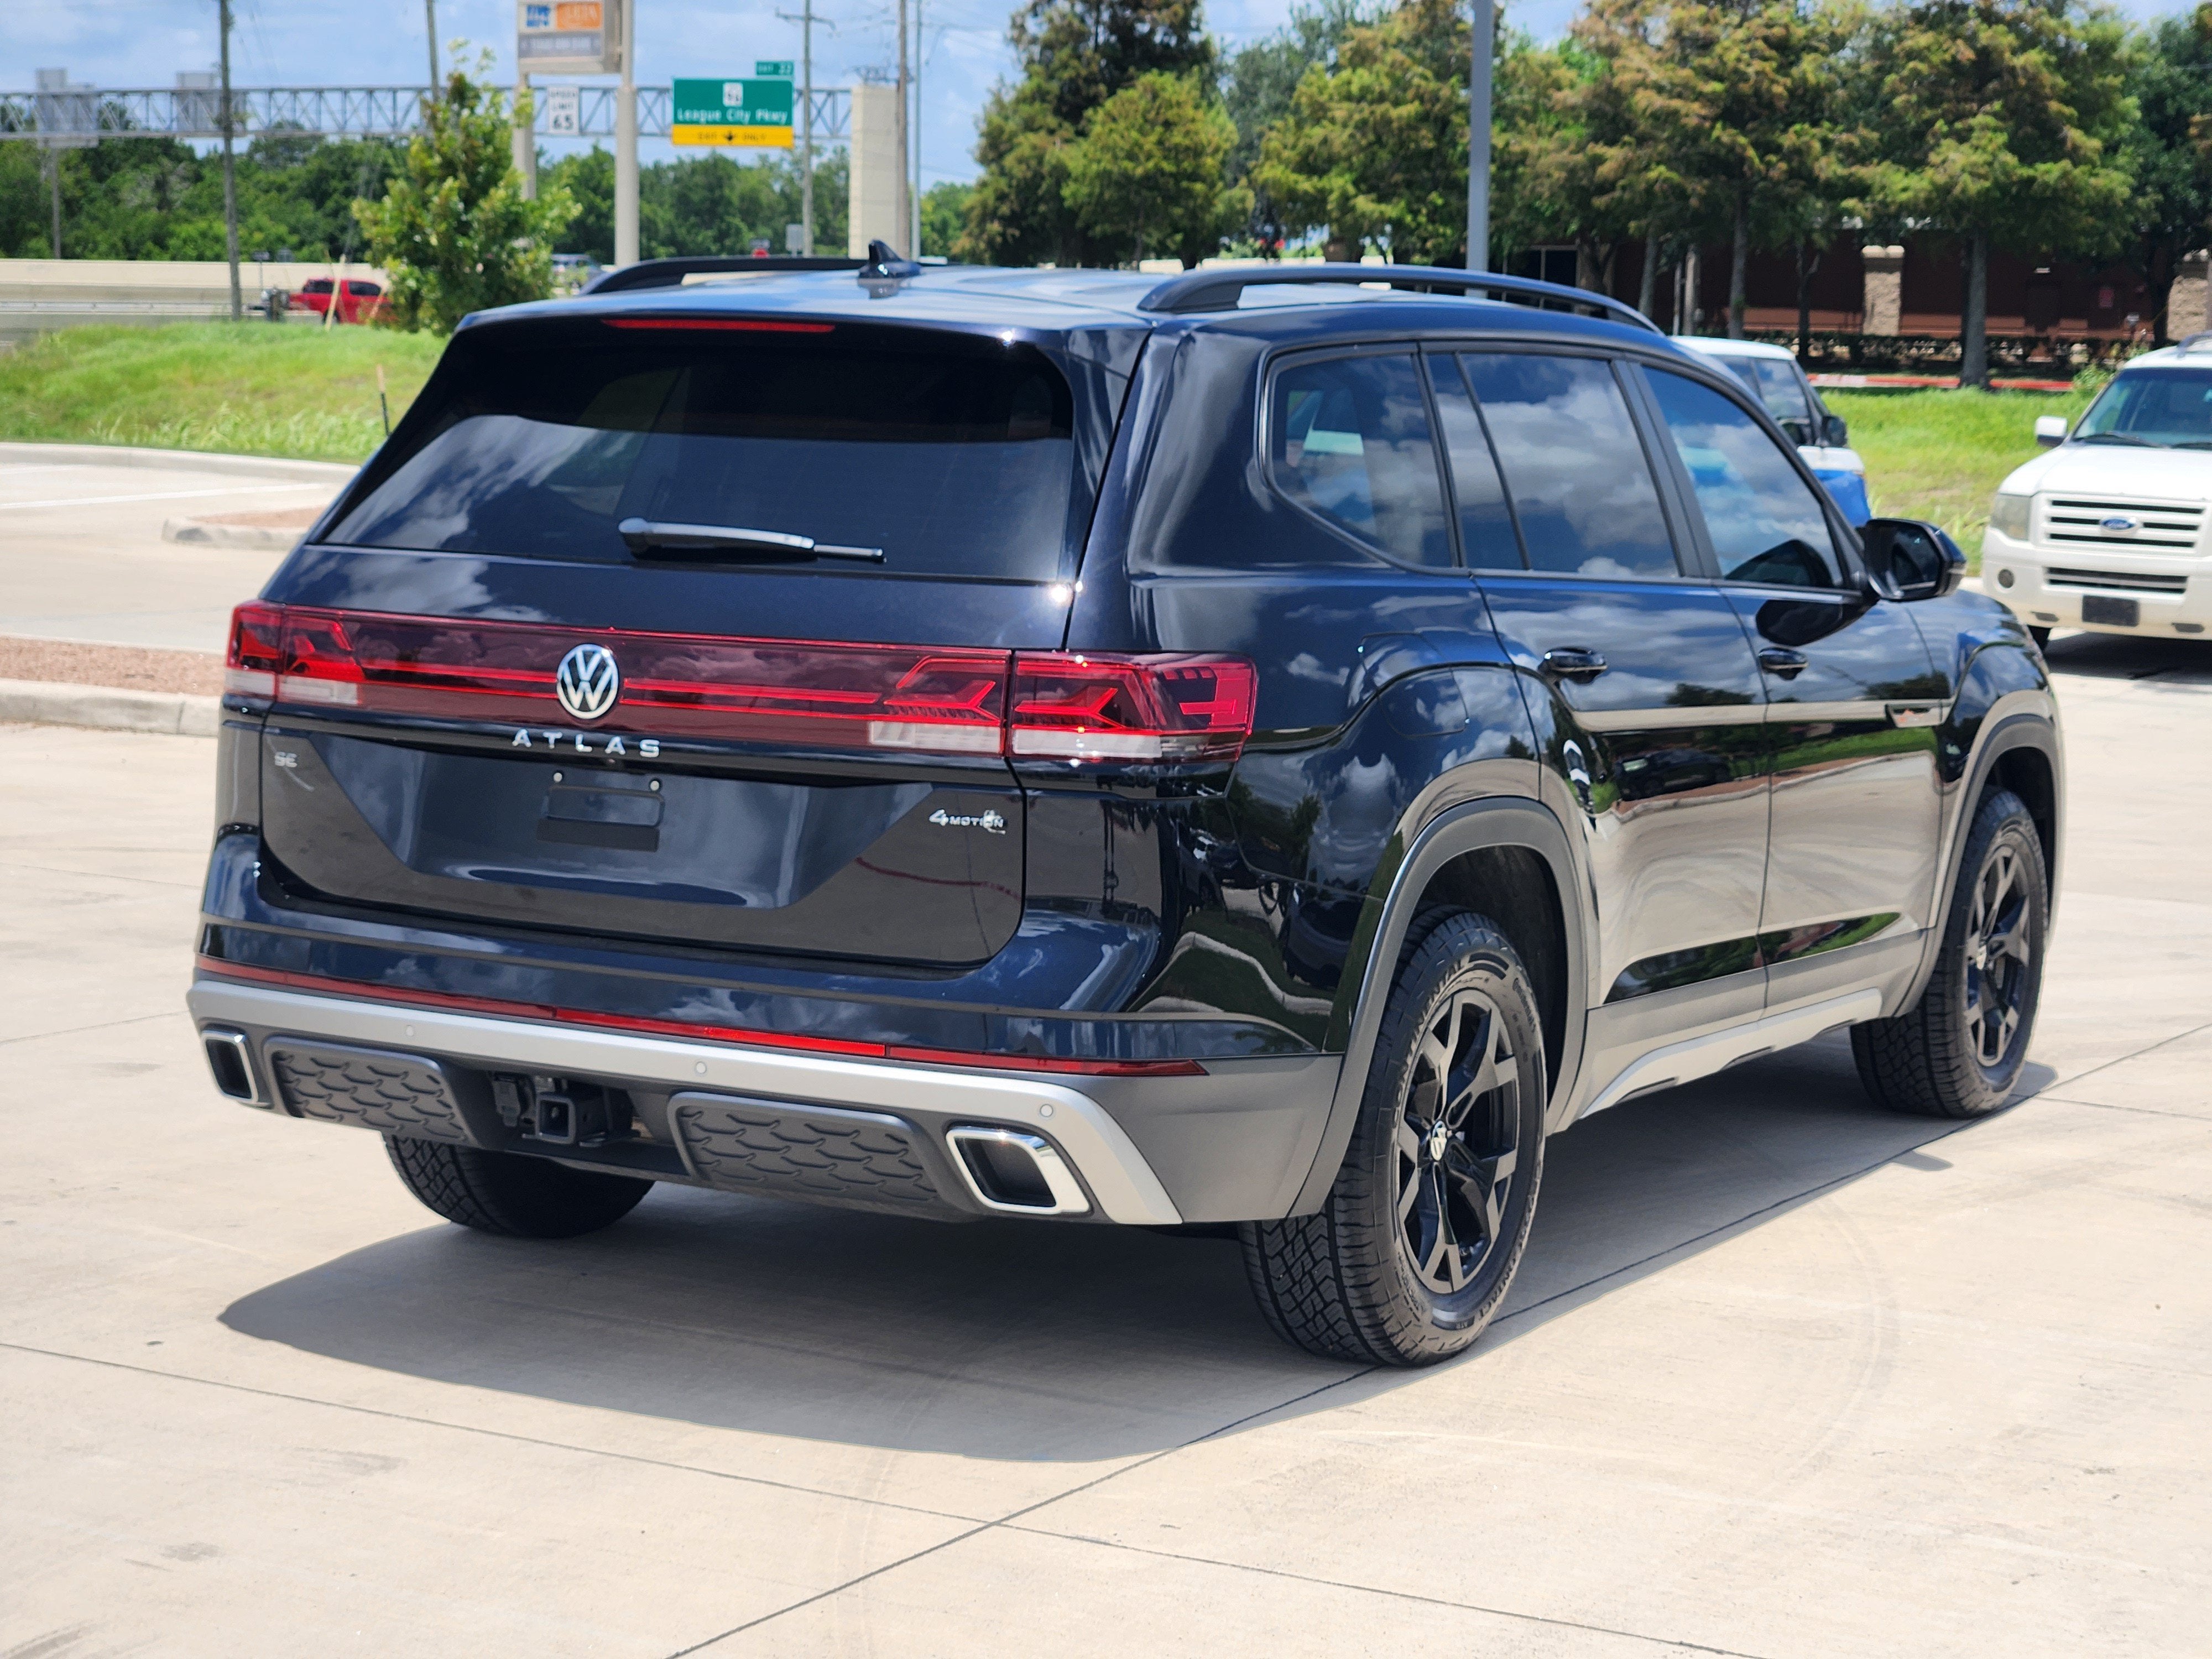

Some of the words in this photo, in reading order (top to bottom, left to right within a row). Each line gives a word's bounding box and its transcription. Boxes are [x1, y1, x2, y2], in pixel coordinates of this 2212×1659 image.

[553, 114, 573, 130] 65
[677, 108, 722, 124] League
[726, 108, 750, 124] City
[755, 108, 788, 124] Pkwy
[512, 728, 660, 758] ATLAS
[274, 751, 298, 768] SE
